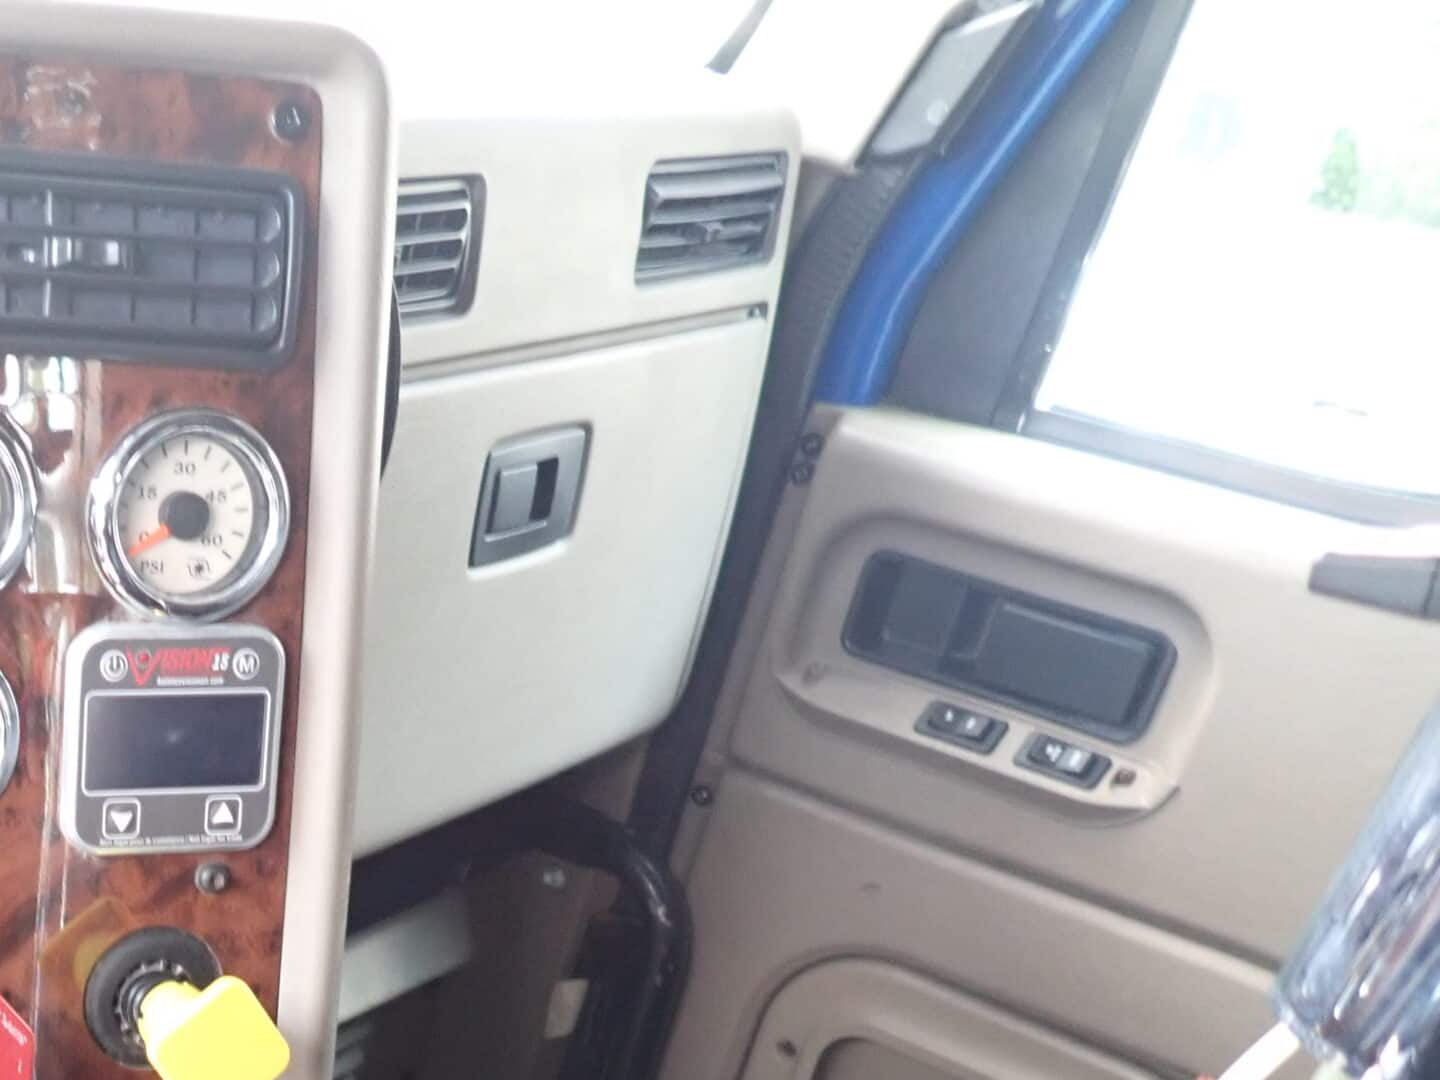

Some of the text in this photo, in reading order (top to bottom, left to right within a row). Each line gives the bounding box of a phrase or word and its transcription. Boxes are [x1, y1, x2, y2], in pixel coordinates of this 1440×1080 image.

[174, 462, 196, 477] 30
[140, 486, 158, 501] 15
[139, 560, 164, 575] PSI
[239, 652, 255, 674] M
